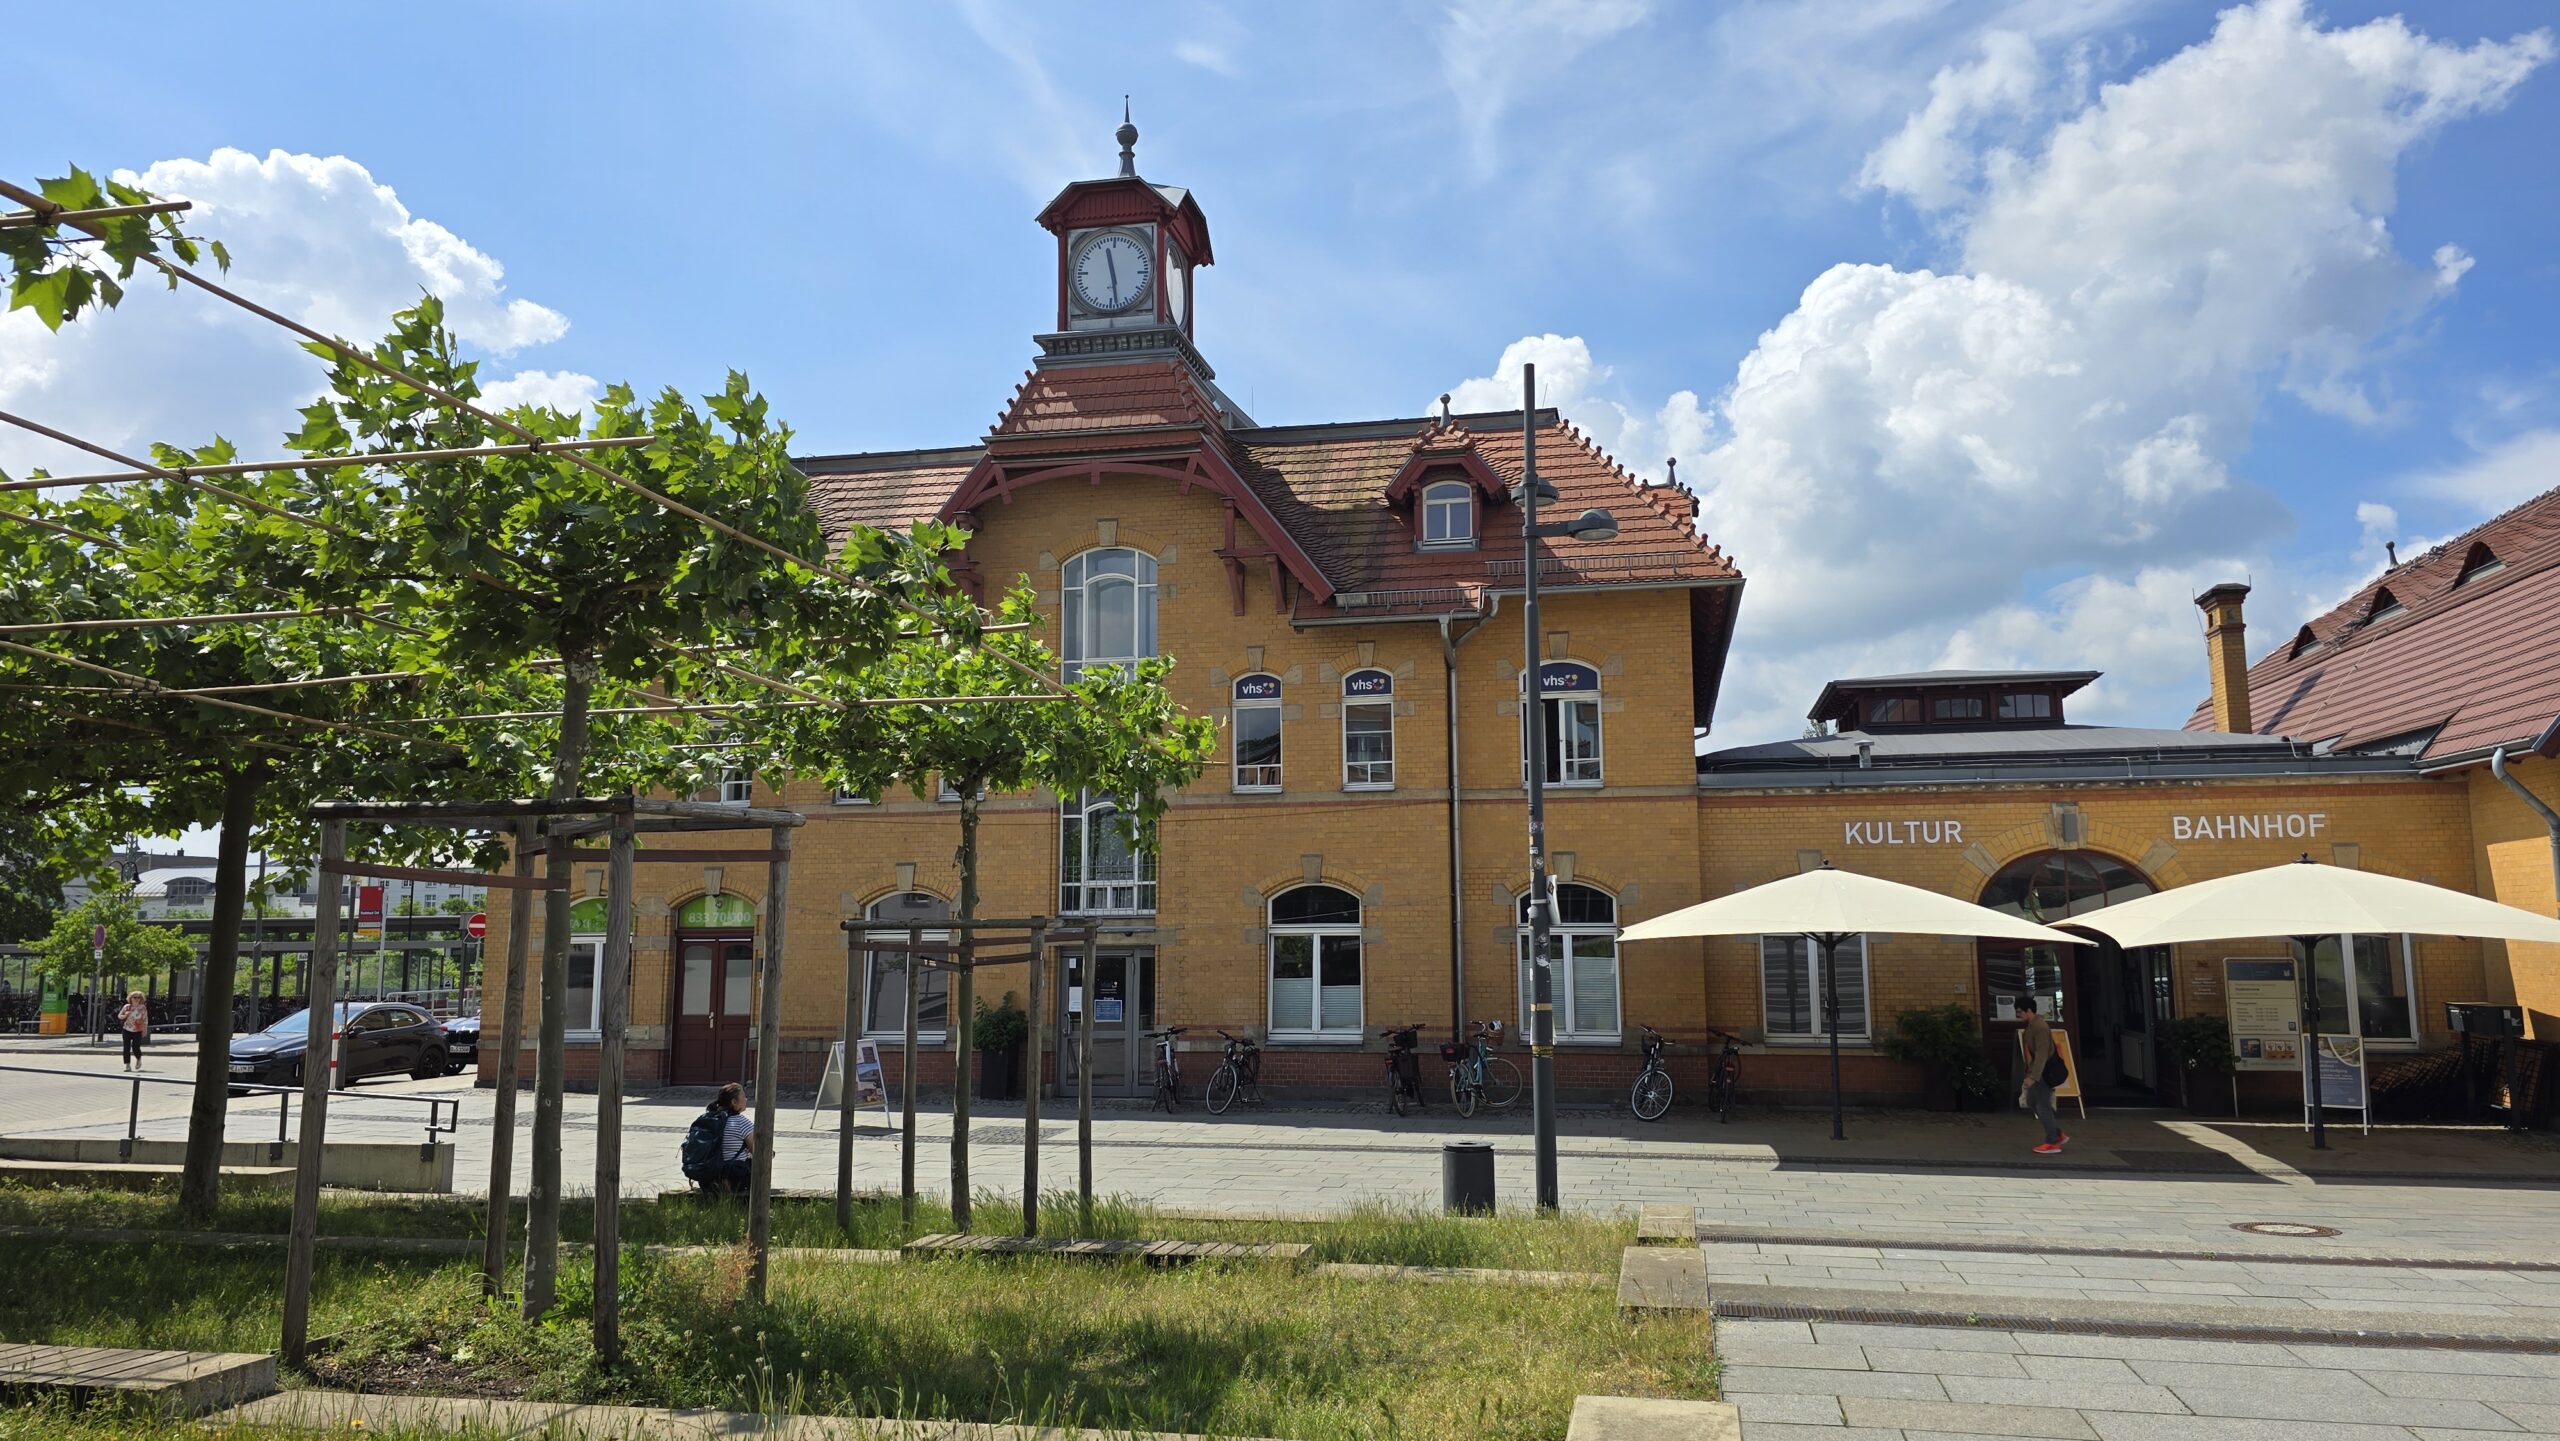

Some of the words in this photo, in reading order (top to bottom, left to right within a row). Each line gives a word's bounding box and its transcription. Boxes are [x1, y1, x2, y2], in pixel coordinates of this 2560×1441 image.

[1352, 680, 1372, 690] vhs
[1543, 674, 1565, 686] vhs
[1242, 682, 1263, 694] vhs
[1845, 820, 1963, 845] KULTUR
[2172, 813, 2326, 840] BAHNHOF
[688, 912, 710, 923] 833
[713, 912, 727, 922] 70
